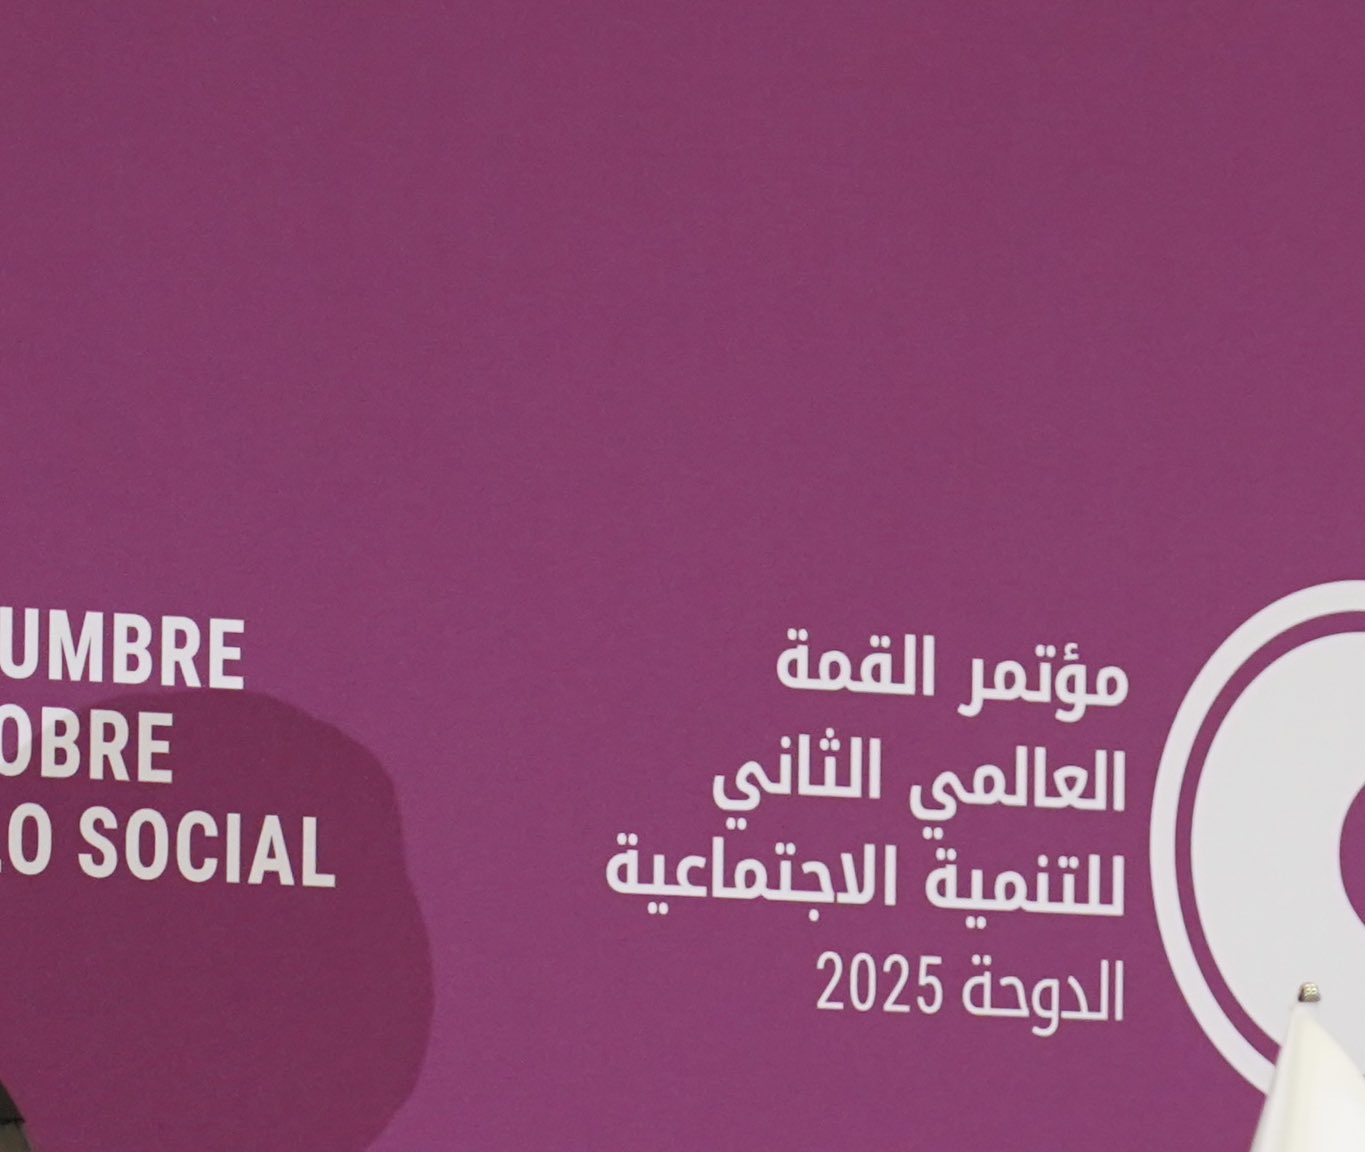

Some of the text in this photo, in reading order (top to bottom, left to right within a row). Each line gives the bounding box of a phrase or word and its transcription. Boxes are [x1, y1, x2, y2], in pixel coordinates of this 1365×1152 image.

[0, 606, 245, 690] UMBRE
[775, 627, 1130, 724] مؤتمر القمة
[0, 703, 174, 783] OBRE
[712, 727, 1127, 840] العالمي الثاني
[0, 802, 337, 888] O SOCIAL
[605, 832, 1126, 930] للتنمية الاجتماعية
[815, 950, 1125, 1038] الدوحة 2025
